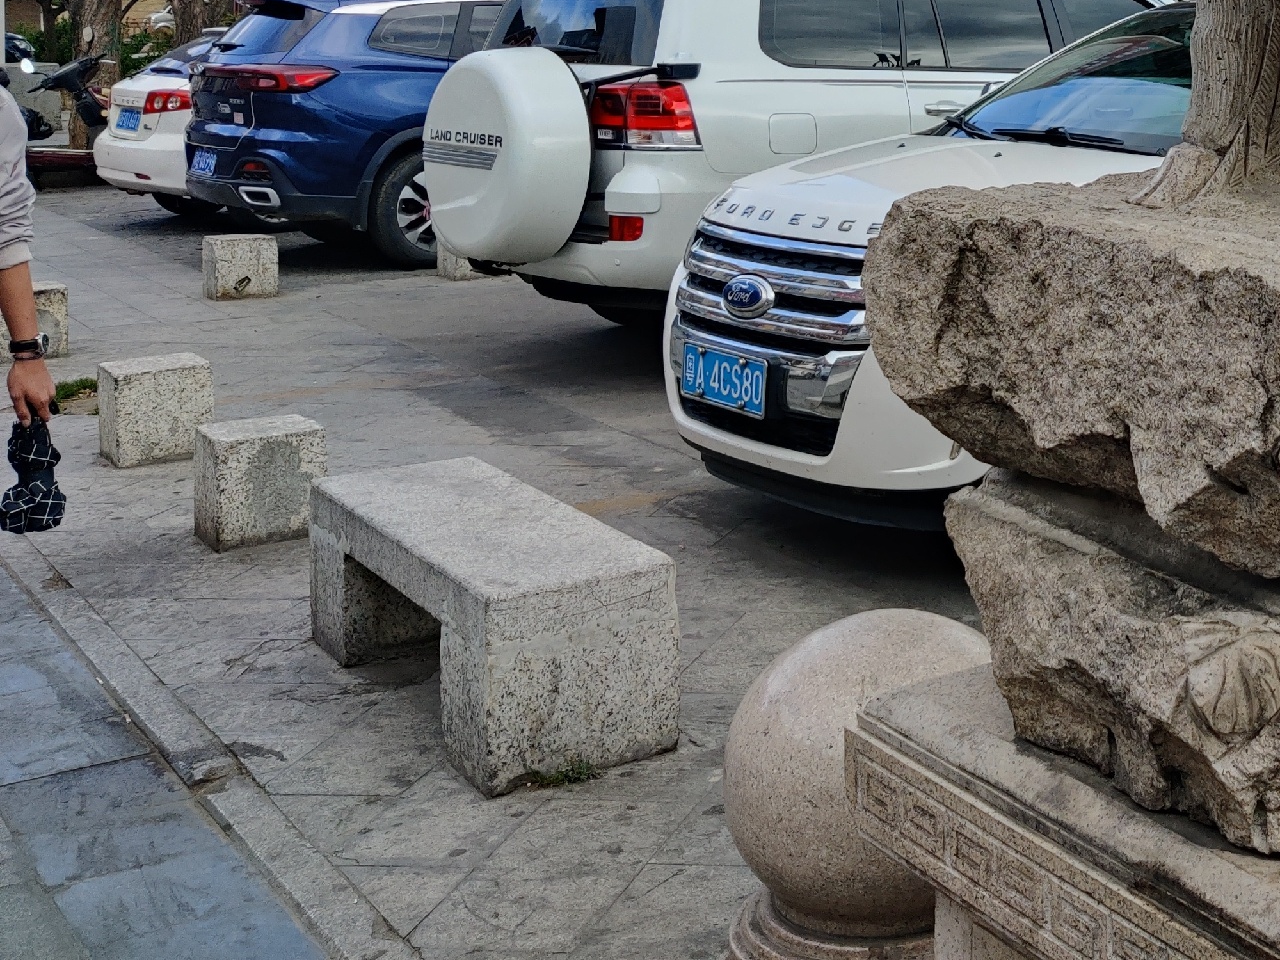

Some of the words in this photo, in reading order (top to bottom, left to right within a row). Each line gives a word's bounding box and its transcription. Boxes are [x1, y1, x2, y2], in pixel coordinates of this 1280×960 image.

[430, 128, 452, 142] LAND
[455, 130, 503, 148] CRUISER
[713, 197, 776, 222] FORD
[788, 213, 884, 235] EDGE
[727, 281, 754, 303] Ford
